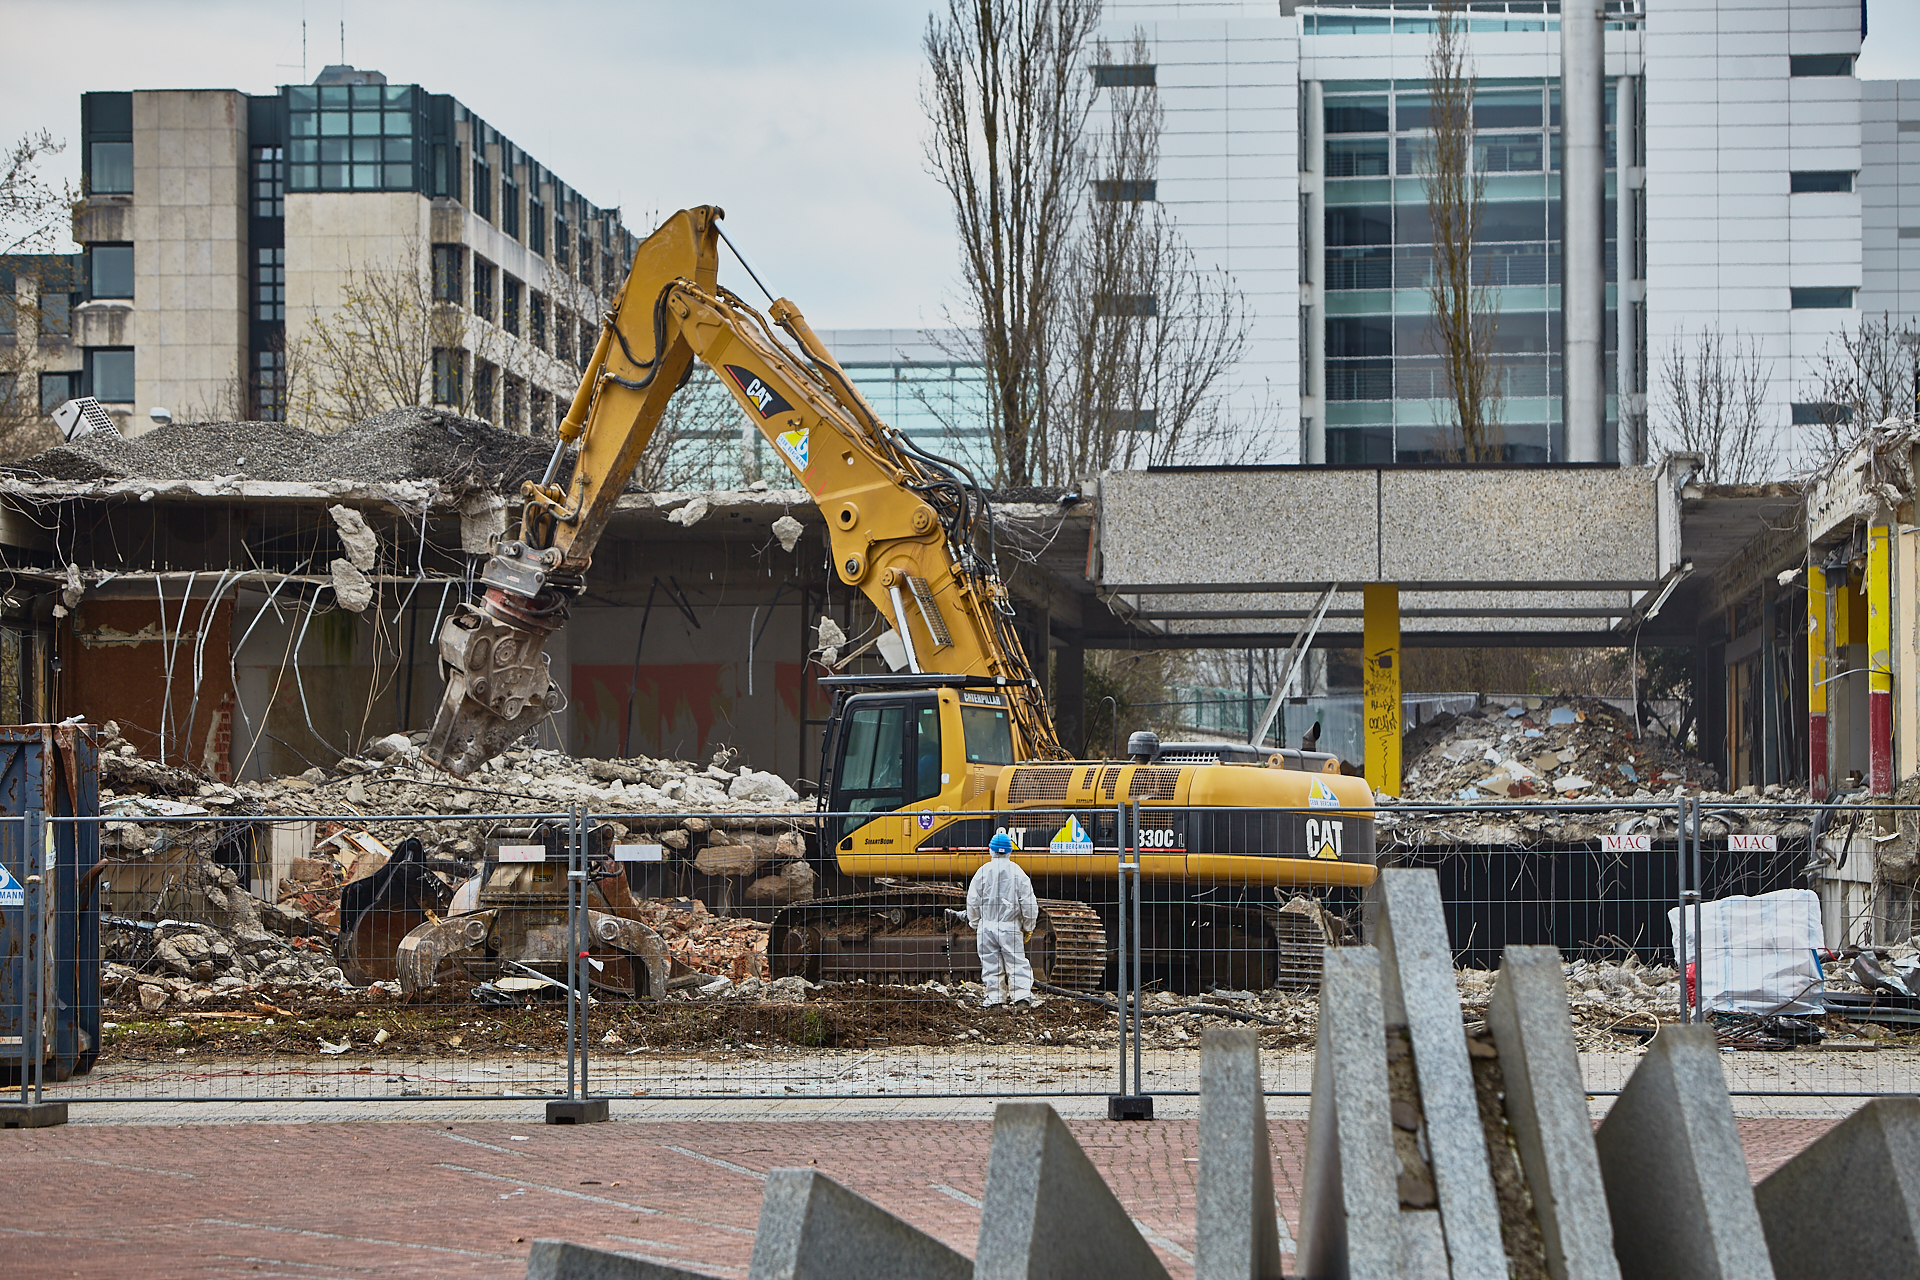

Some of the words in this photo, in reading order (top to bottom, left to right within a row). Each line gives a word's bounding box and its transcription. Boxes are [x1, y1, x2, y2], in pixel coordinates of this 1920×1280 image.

[746, 378, 773, 411] CAT
[963, 692, 1002, 706] CATERPILLAR
[1138, 829, 1174, 847] 330C
[1306, 818, 1343, 858] CAT
[1607, 835, 1647, 849] MAC
[1733, 835, 1773, 849] MAC
[503, 847, 541, 861] MAC
